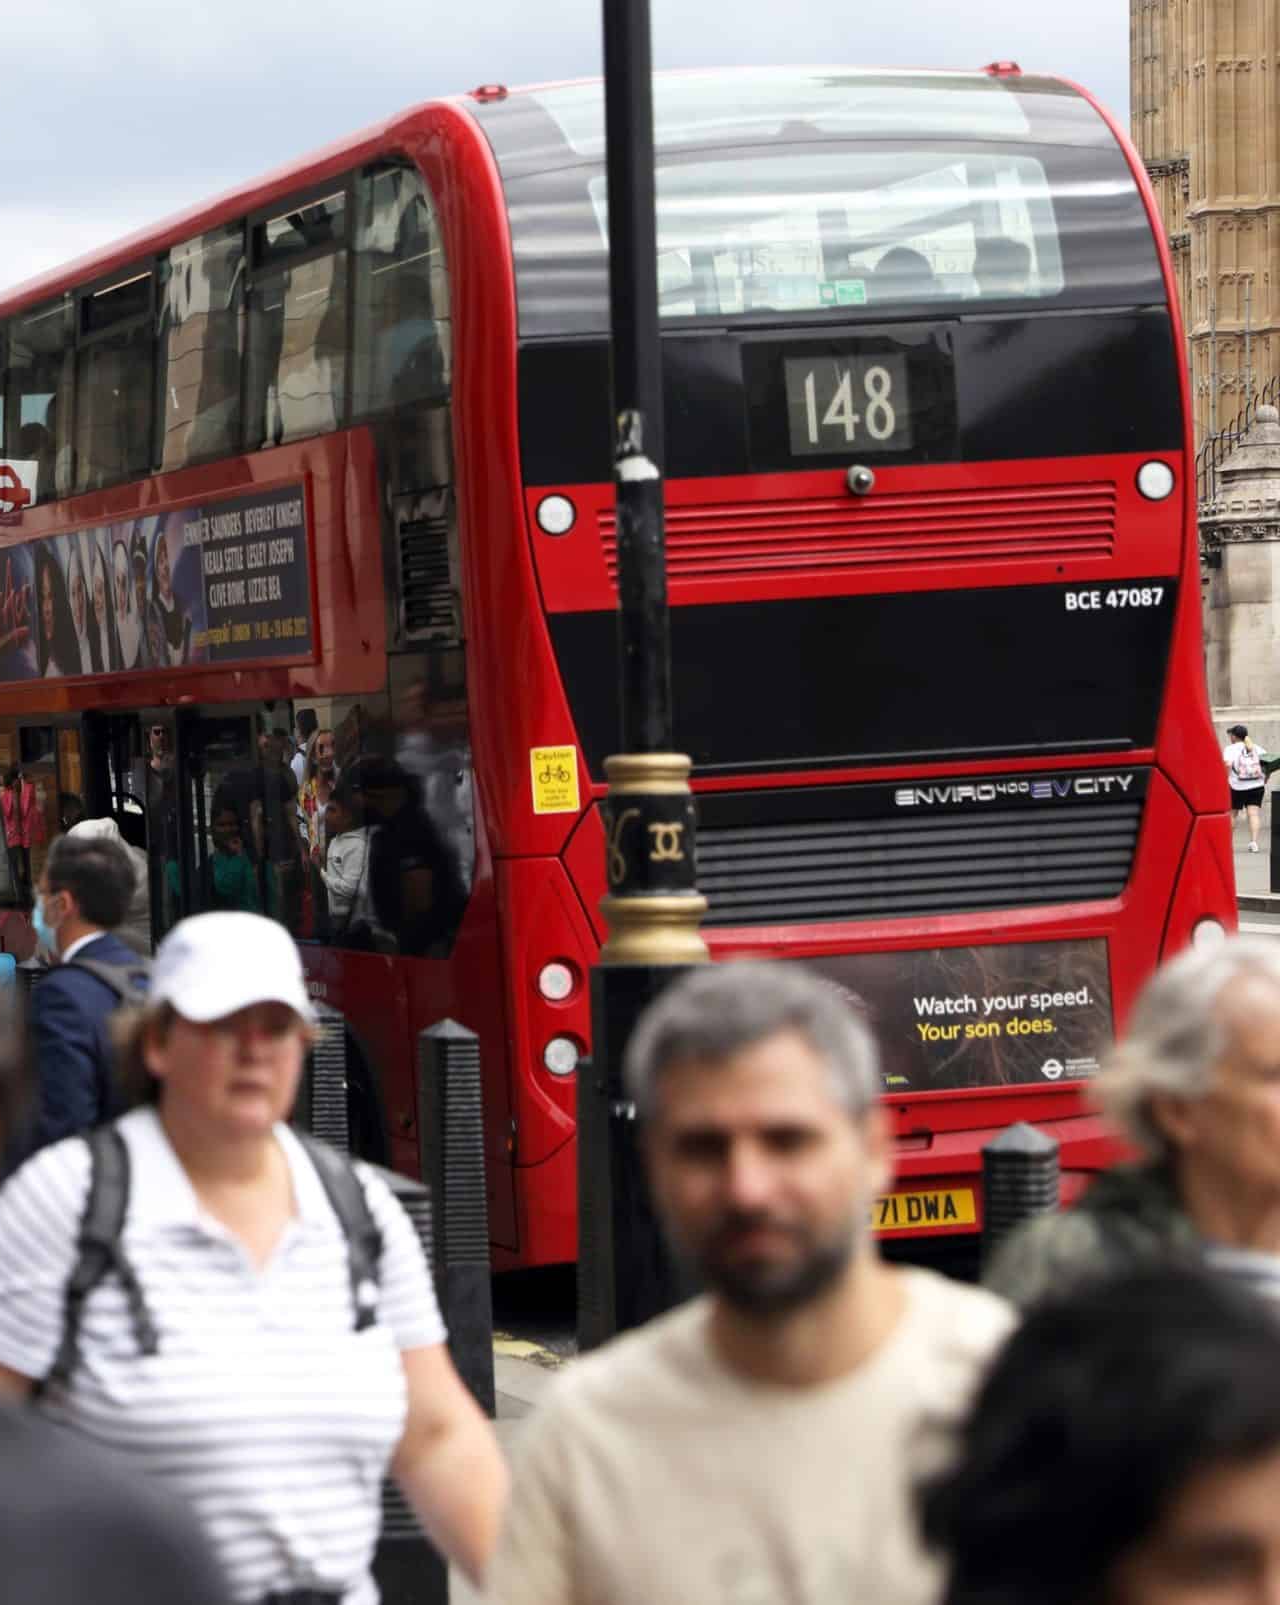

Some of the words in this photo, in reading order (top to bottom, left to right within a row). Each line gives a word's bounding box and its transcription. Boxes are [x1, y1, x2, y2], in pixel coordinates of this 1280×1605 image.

[804, 366, 896, 443] 148
[1065, 590, 1102, 611] BCE
[1105, 586, 1165, 608] 47087
[913, 994, 977, 1016] Watch
[982, 994, 1027, 1016] your
[1029, 986, 1094, 1012] speed.
[917, 1022, 961, 1041] Your
[964, 1020, 1001, 1039] son
[1005, 1016, 1058, 1035] does.
[905, 1194, 958, 1222] DWA
